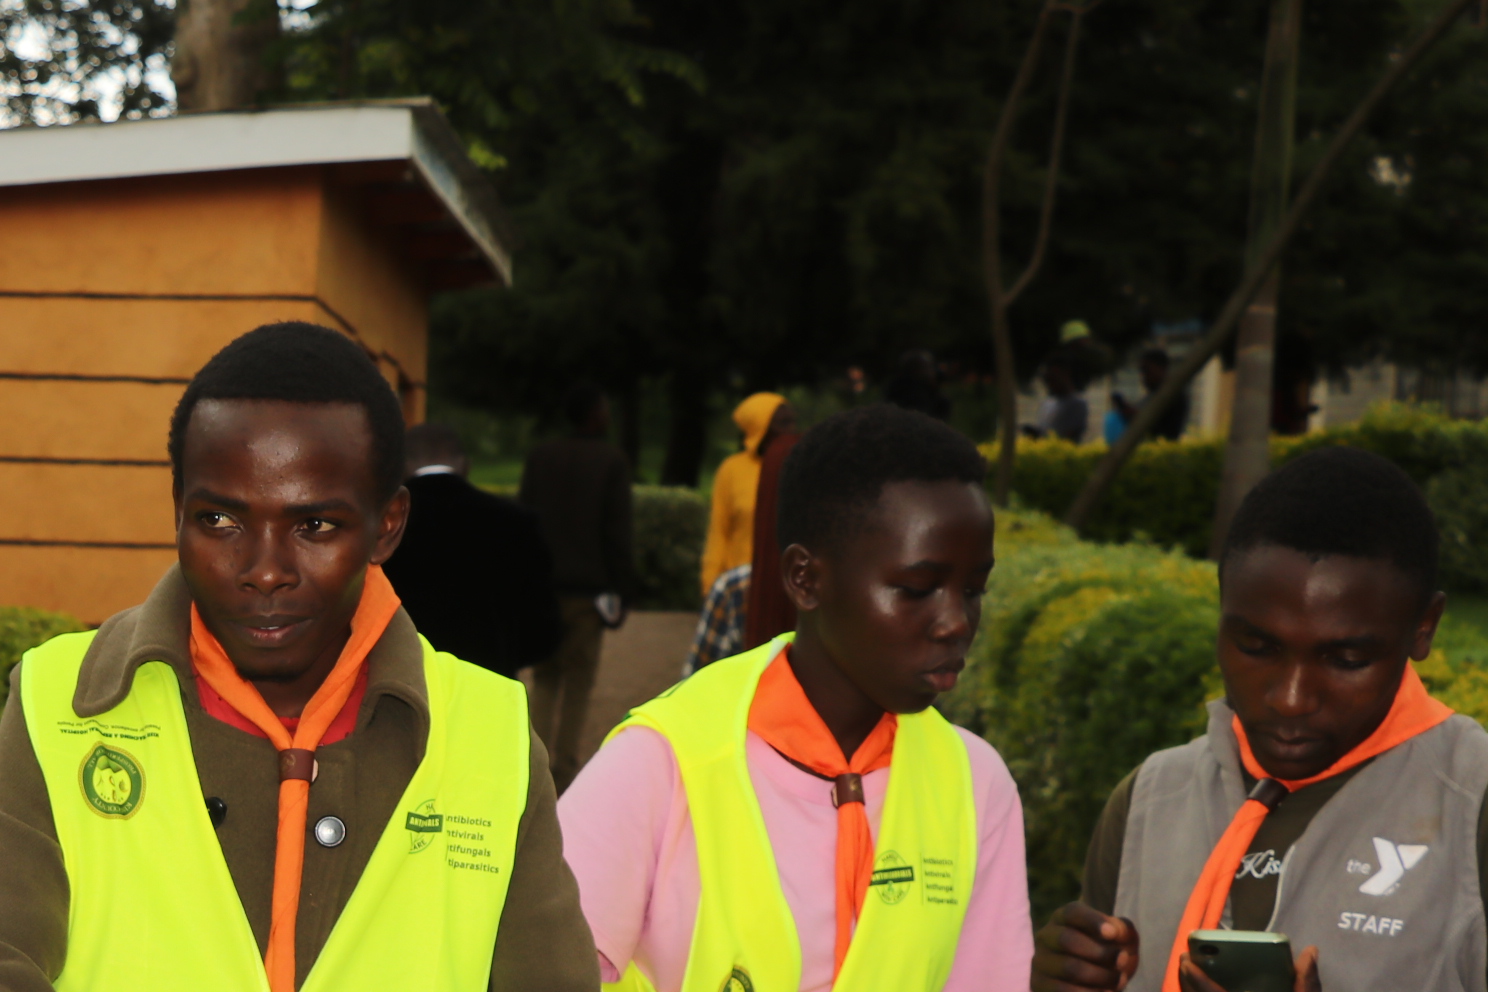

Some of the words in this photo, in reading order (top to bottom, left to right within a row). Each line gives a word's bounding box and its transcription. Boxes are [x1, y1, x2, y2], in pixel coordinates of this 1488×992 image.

[446, 814, 492, 828] ntibiotics
[448, 858, 500, 874] tiparasitics
[1337, 911, 1404, 937] STAFF
